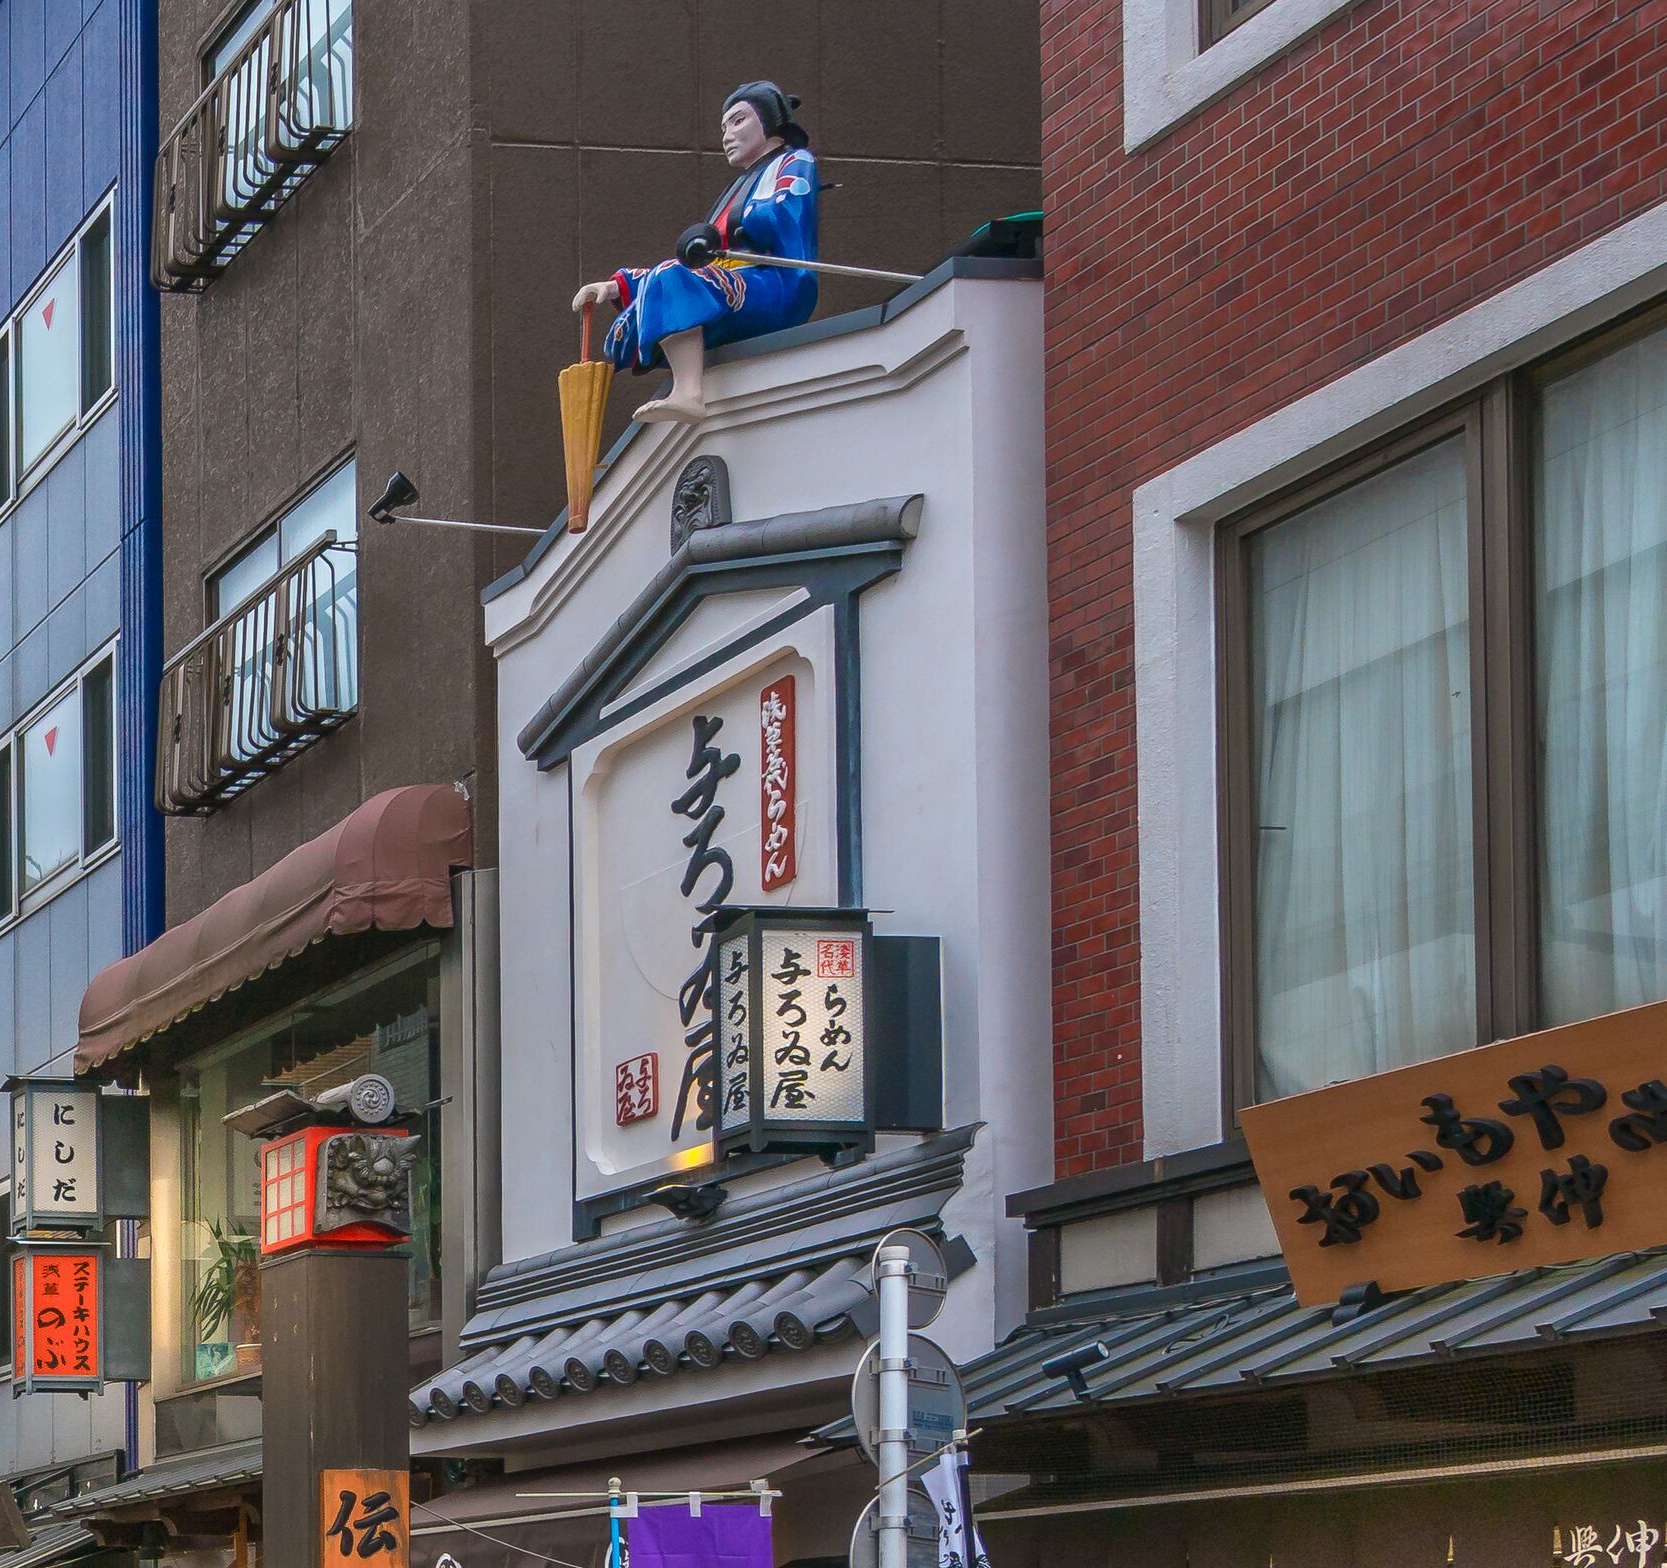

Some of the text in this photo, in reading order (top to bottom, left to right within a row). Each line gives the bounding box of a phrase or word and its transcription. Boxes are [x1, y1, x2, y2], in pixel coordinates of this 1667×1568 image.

[770, 946, 815, 1110] 与ろゐ屋
[52, 1103, 76, 1202] にしだ
[37, 1306, 67, 1370] のぶ
[73, 1261, 91, 1371] ステーキハウス
